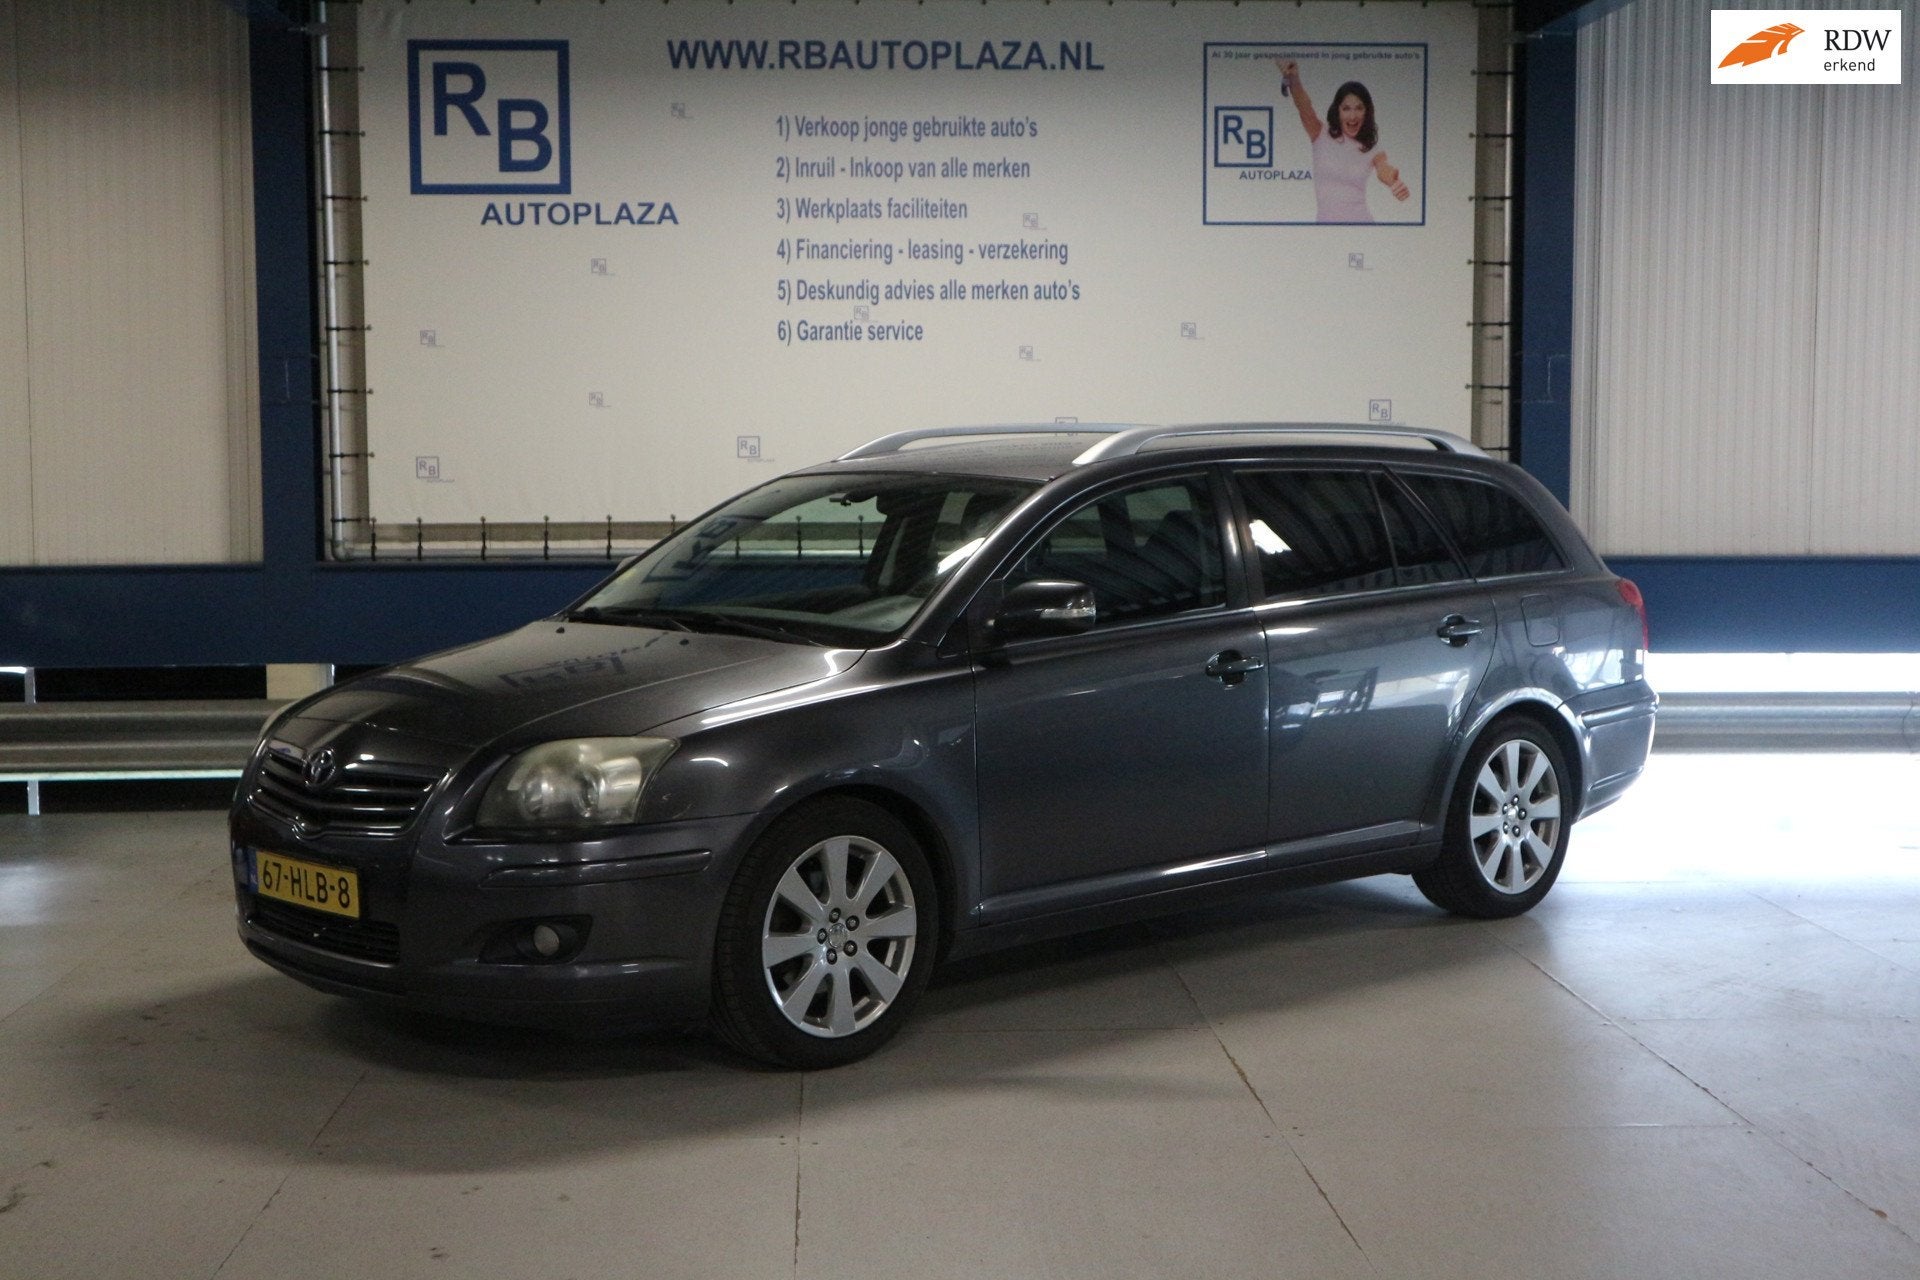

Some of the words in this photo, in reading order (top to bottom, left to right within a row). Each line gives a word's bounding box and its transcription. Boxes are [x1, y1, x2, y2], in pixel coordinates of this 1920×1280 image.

[666, 40, 1105, 71] WWW.RBAUTOPLAZA.NL
[432, 61, 553, 173] RB
[776, 116, 790, 141] 1)
[795, 116, 859, 141] Verkoop
[863, 116, 908, 142] jonge
[913, 116, 986, 142] gebruikte
[991, 116, 1038, 137] auto's
[1222, 114, 1268, 159] RB
[776, 157, 790, 182] 2)
[795, 156, 835, 178] Inruil
[849, 156, 904, 182] Inkoop
[908, 161, 935, 179] van
[940, 156, 968, 178] alle
[973, 156, 1031, 178] merken
[1239, 169, 1313, 180] AUTOPLAZA
[480, 202, 680, 226] AUTOPLAZA
[776, 198, 791, 223] 3)
[795, 197, 882, 224] Werkplaats
[887, 197, 968, 219] faciliteiten
[776, 239, 791, 264] 4)
[796, 238, 894, 265] Financiering
[908, 238, 964, 265] leasing
[978, 238, 1069, 265] verzekering
[777, 279, 791, 305] 5)
[797, 279, 879, 306] Deskundig
[884, 279, 936, 301] advies
[939, 279, 967, 301] alle
[971, 279, 1029, 301] merken
[1033, 279, 1080, 301] auto's
[777, 320, 792, 346] 6)
[797, 320, 863, 342] Garantie
[867, 320, 924, 342] service
[262, 860, 350, 909] 67-HLB-8
